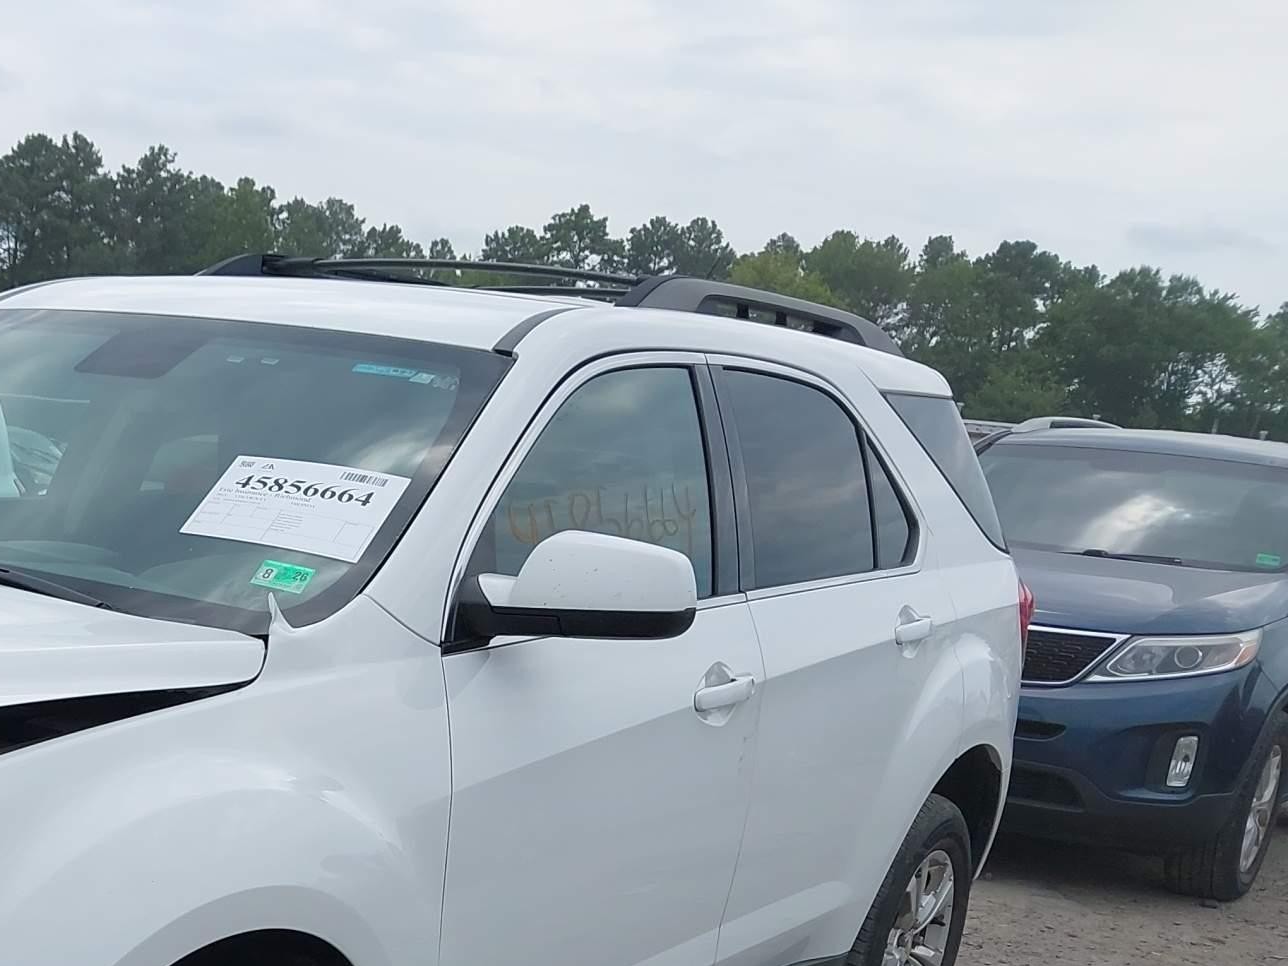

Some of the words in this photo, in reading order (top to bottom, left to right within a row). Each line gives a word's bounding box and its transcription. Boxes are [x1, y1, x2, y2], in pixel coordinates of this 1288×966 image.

[235, 474, 376, 507] 45856664
[262, 568, 274, 579] 8
[292, 571, 309, 582] 26
